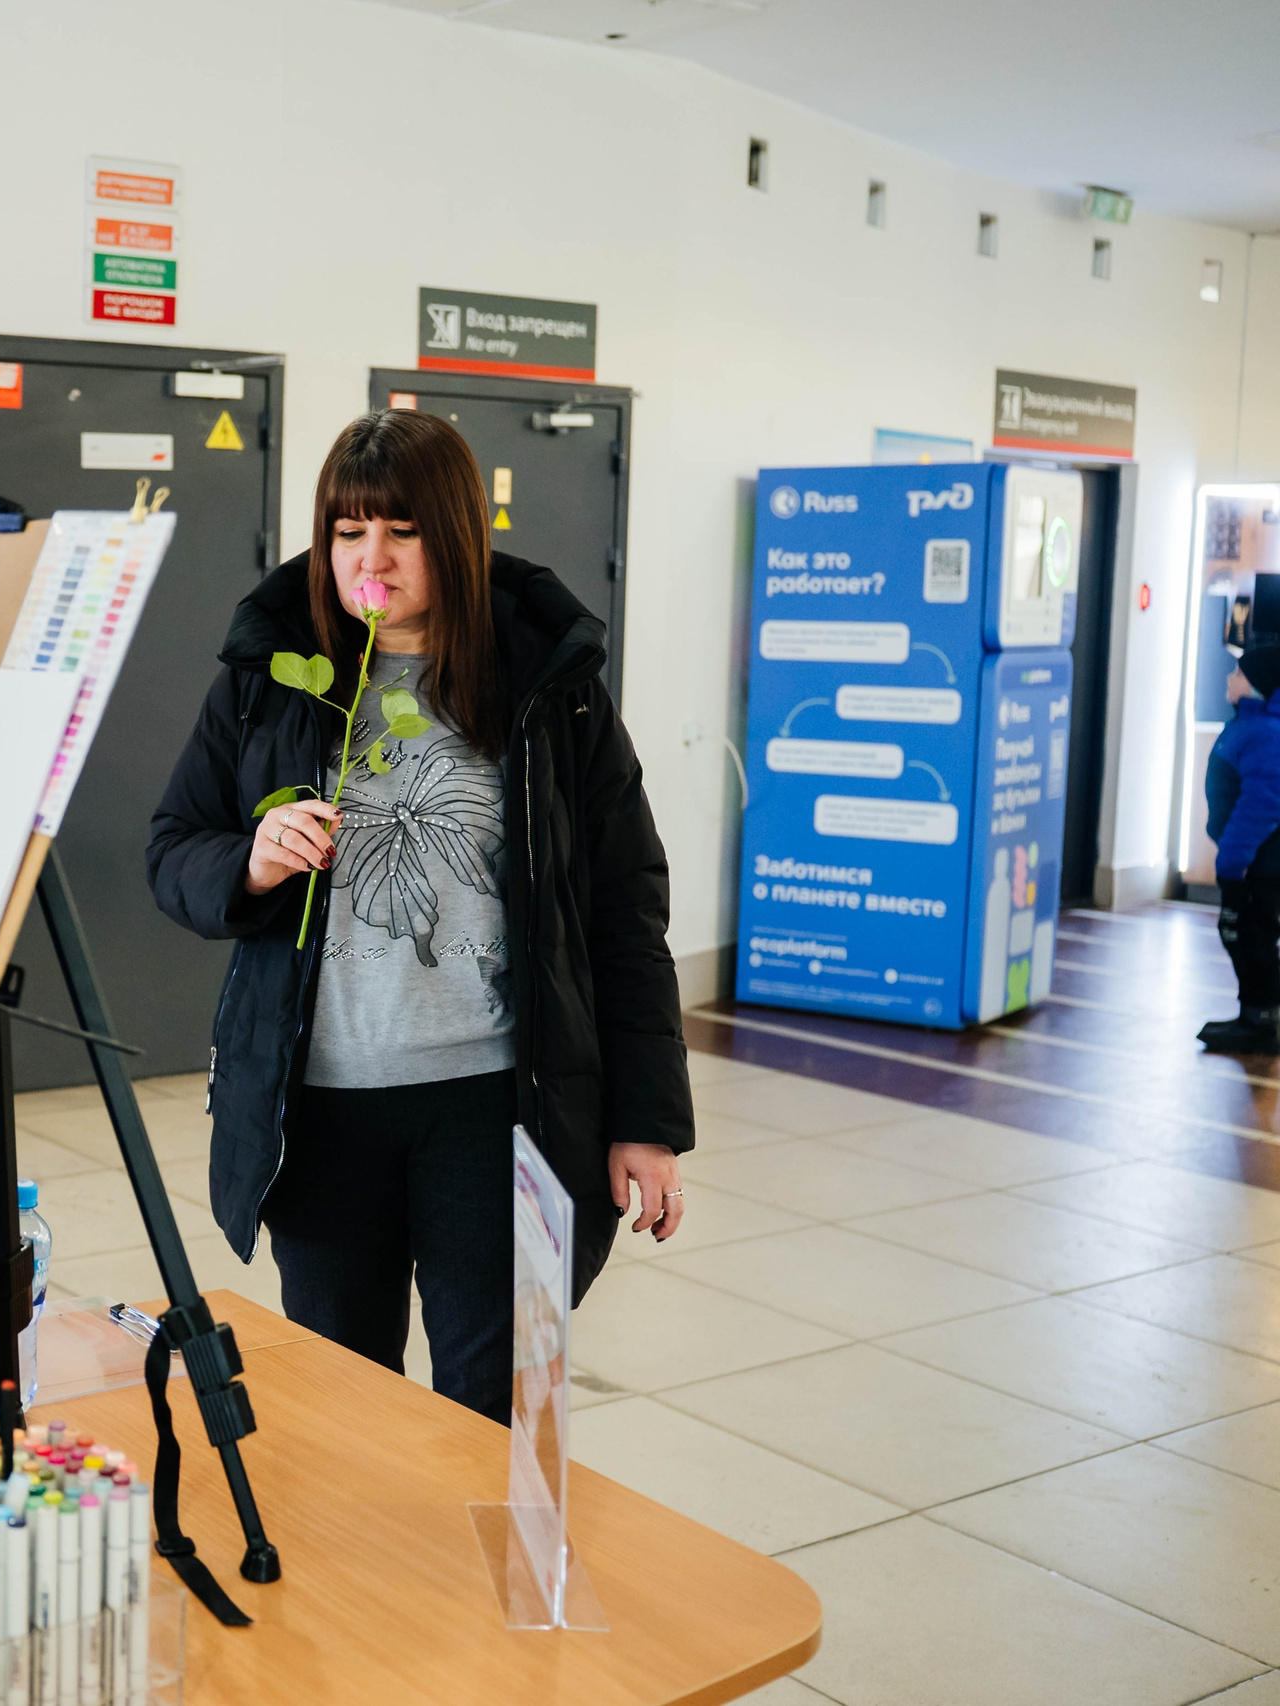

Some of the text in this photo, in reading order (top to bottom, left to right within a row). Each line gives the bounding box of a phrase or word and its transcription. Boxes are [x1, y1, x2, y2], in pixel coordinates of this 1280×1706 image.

[103, 293, 165, 309] ПОРОШОК
[465, 307, 588, 339] Вход запрещен
[465, 335, 519, 358] No entry
[803, 491, 859, 514] Russ
[767, 547, 852, 570] Как это
[765, 571, 886, 598] работает?
[753, 854, 873, 886] Заботимся
[752, 882, 948, 919] о планете вместе
[749, 936, 848, 961] ecoplatform
